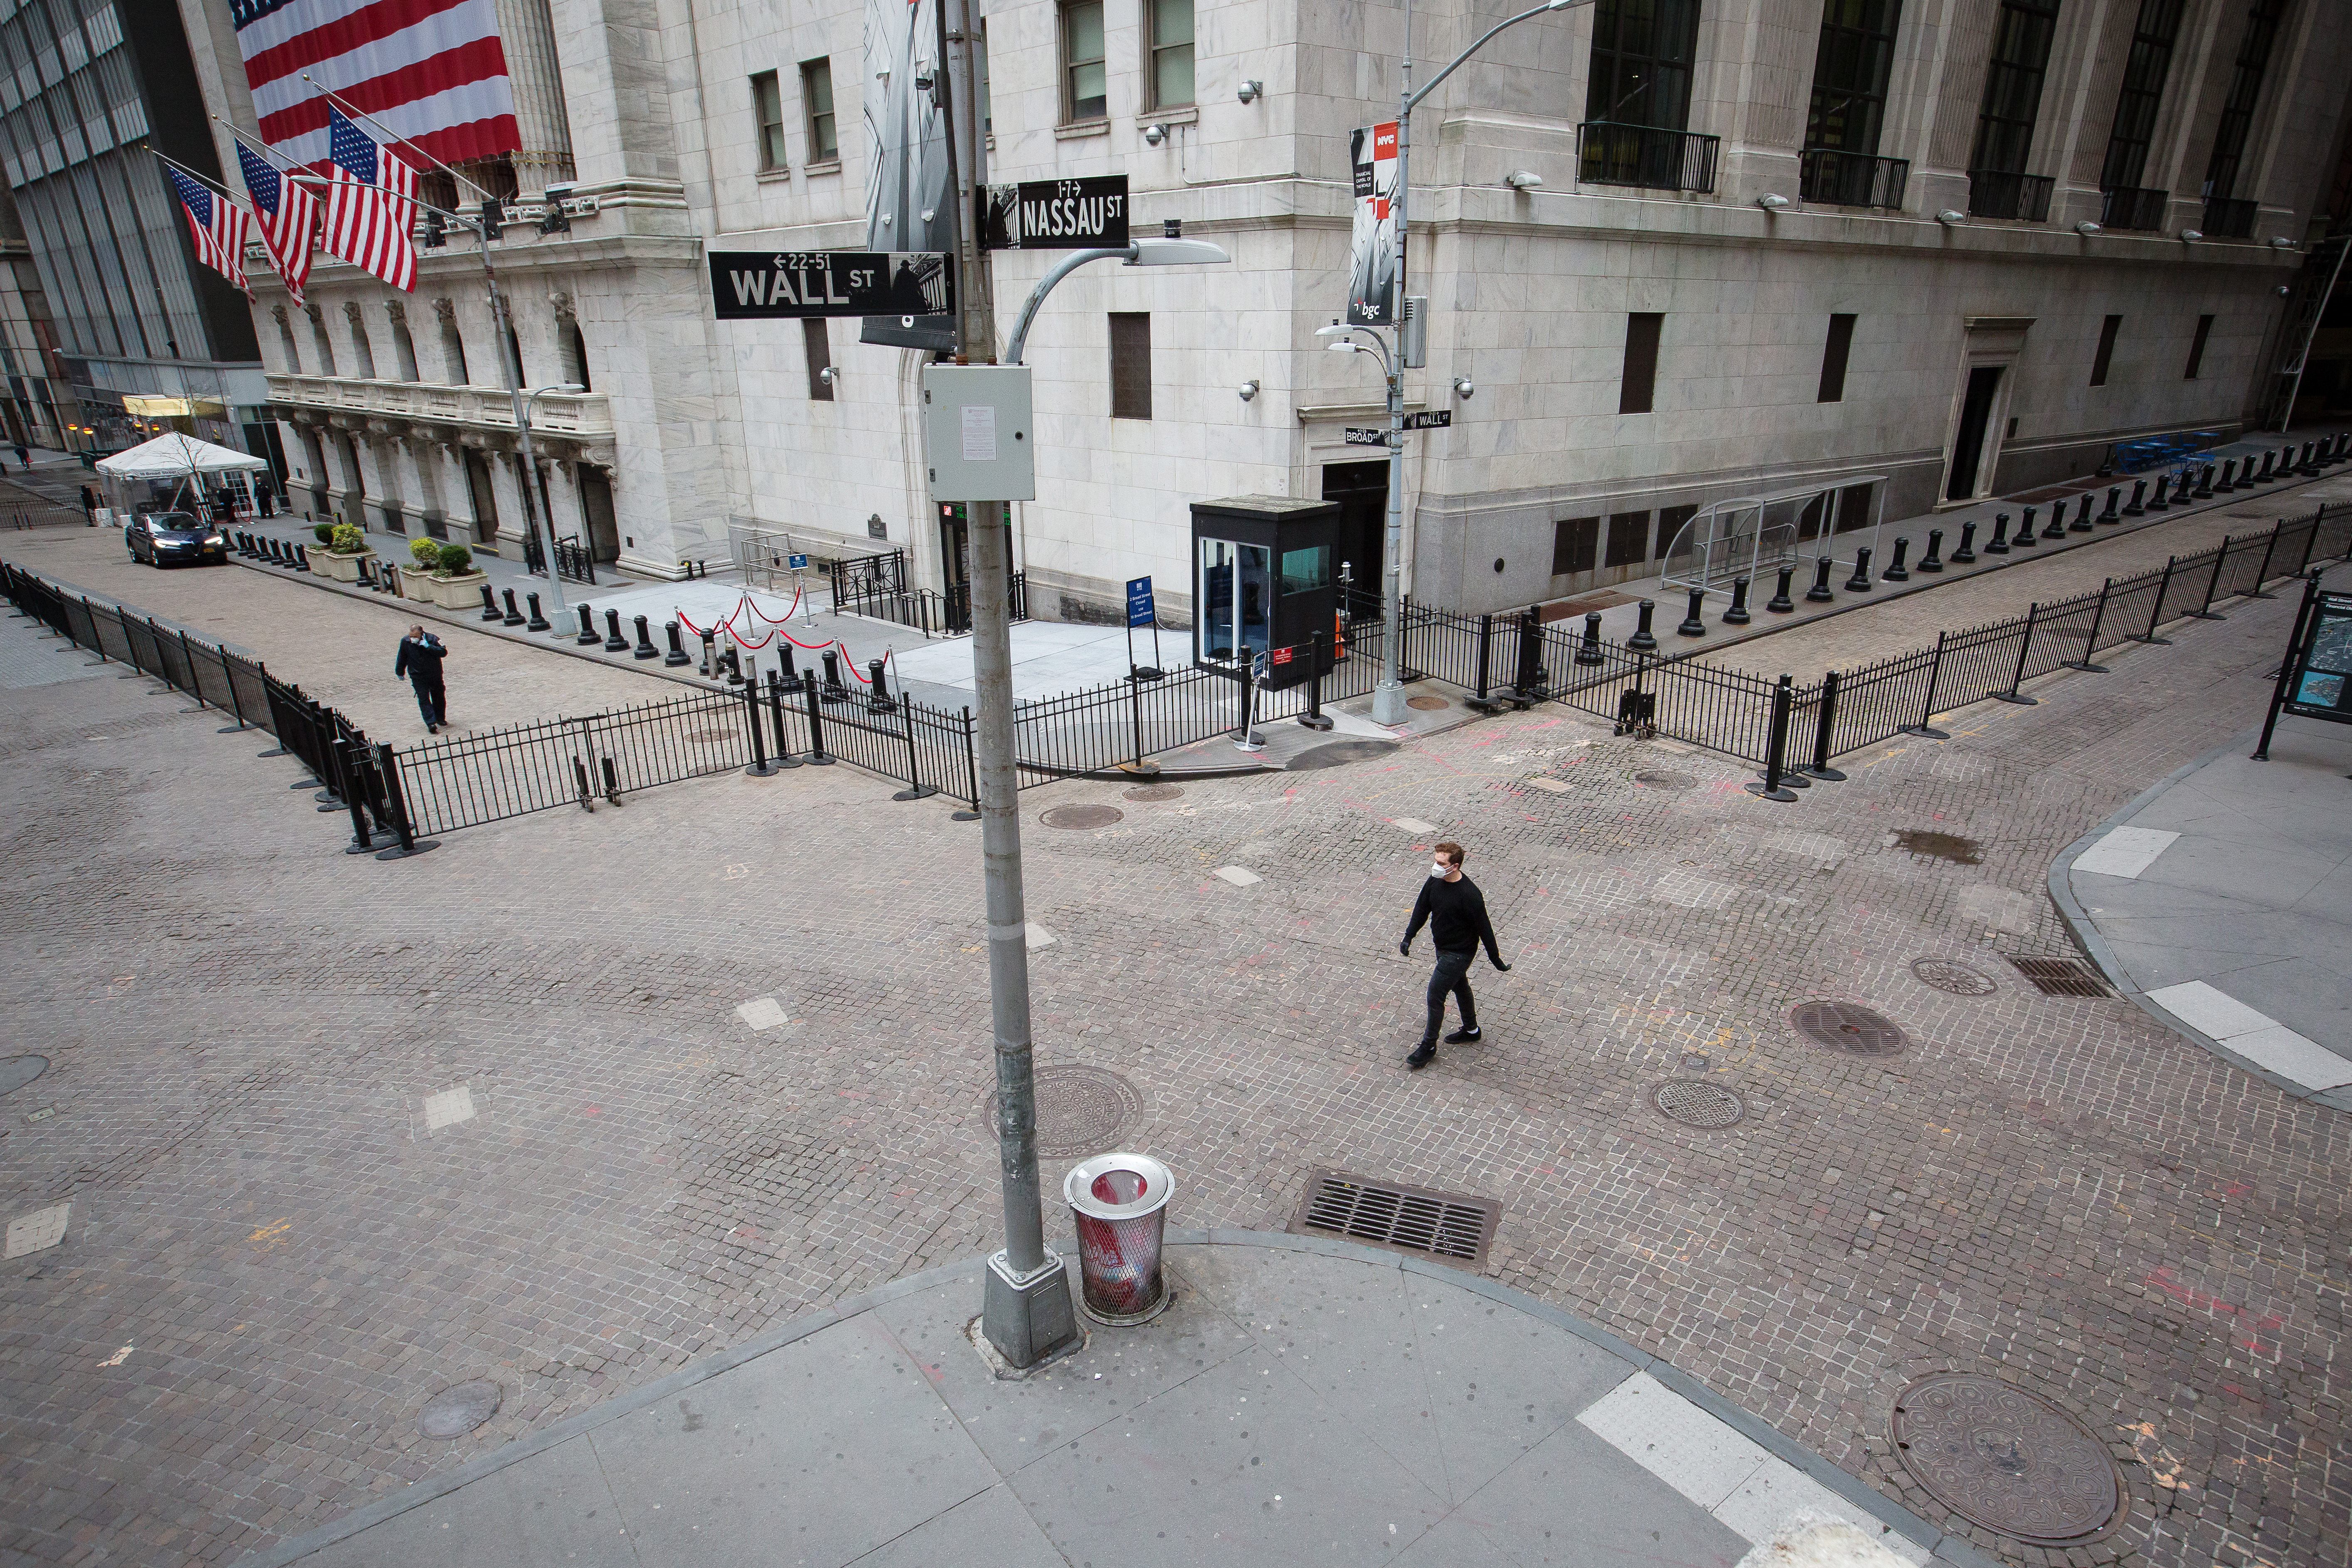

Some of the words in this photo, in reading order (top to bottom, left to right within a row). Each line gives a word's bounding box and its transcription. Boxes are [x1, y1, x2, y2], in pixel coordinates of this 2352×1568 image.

[1378, 134, 1394, 146] NYC
[1058, 181, 1071, 198] 1-7
[1024, 197, 1104, 236] NASSAU
[1107, 195, 1122, 218] ST
[789, 253, 830, 270] 22-51
[729, 270, 849, 305] WALL
[850, 270, 874, 287] ST
[1362, 302, 1380, 320] bgc
[1420, 415, 1442, 426] WALL
[1346, 431, 1373, 443] BROAD
